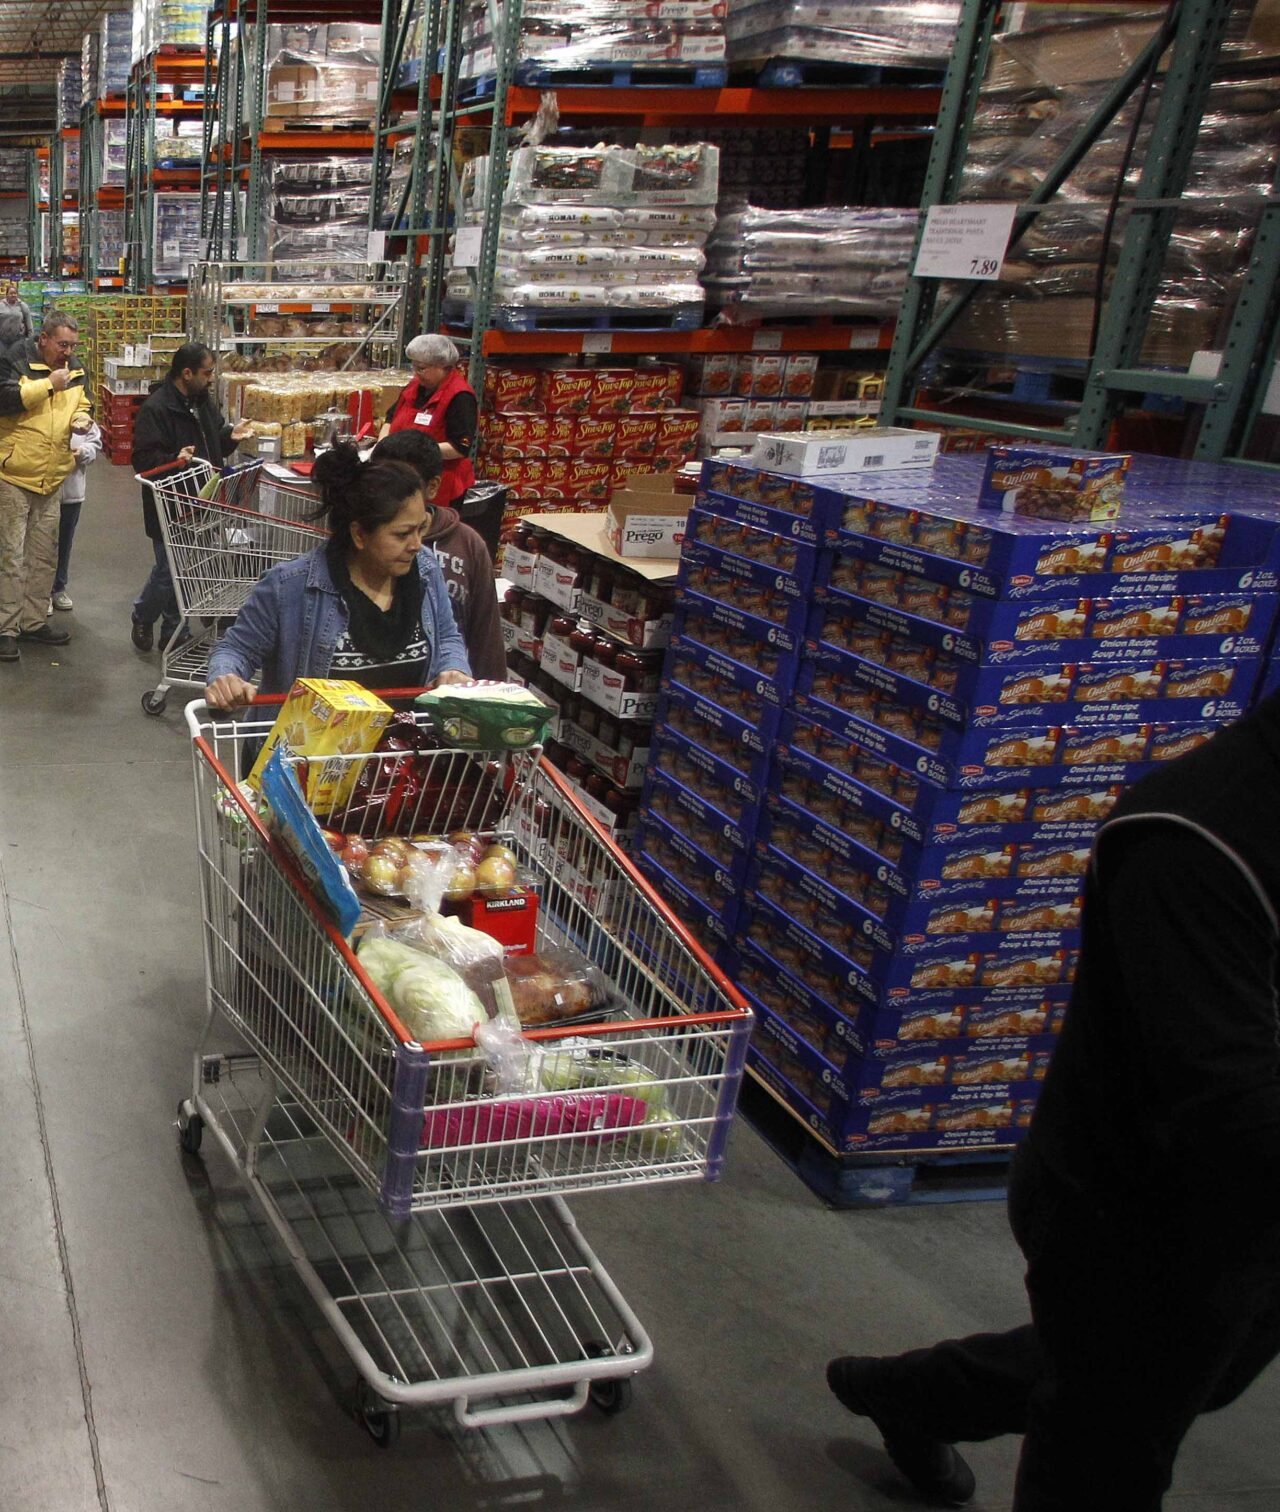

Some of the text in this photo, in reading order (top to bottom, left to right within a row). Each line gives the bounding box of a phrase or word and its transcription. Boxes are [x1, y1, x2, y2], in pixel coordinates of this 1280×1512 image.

[970, 260, 998, 276] 7.89
[552, 379, 592, 397] Stove Top
[593, 378, 636, 397] Stove Top
[652, 376, 666, 388] Top
[576, 422, 616, 440] Stove Top
[617, 422, 656, 440] Stove Top
[658, 420, 699, 440] Stove Top
[570, 464, 609, 481] Stove Top
[1003, 471, 1038, 485] Onion
[676, 520, 684, 528] 18
[792, 520, 800, 535] 6
[626, 530, 663, 544] Prego
[1123, 549, 1158, 568] Onion
[775, 576, 783, 590] 6
[959, 570, 970, 588] 6
[972, 572, 990, 585] 2oz.
[1120, 574, 1178, 584] Onion Recipe
[1238, 572, 1253, 589] 6
[1252, 578, 1278, 588] BOXES
[1256, 571, 1274, 580] 2oz.
[972, 582, 996, 596] BOXES
[1111, 583, 1178, 594] Soup & Dip Mix
[579, 596, 603, 618] Prego
[1103, 615, 1139, 635] Onion
[1195, 612, 1230, 632] Onion
[768, 628, 776, 642] 6
[942, 634, 952, 650] 6
[1237, 636, 1256, 646] 2oz.
[1100, 639, 1158, 650] Onion Recipe
[1220, 636, 1234, 654] 6
[1234, 644, 1260, 654] BOXES
[1092, 650, 1115, 658] Soup
[1124, 648, 1139, 658] Dip
[1140, 649, 1158, 657] Mix
[1087, 680, 1121, 698] Onion
[1177, 676, 1212, 696] Onion
[310, 701, 320, 714] 2
[624, 698, 655, 714] Pre
[928, 694, 938, 711] 6
[1082, 702, 1139, 714] Onion Recipe
[1202, 700, 1216, 718] 6
[939, 708, 961, 722] BOXES
[1216, 708, 1242, 717] BOXES
[1073, 742, 1108, 760] Onion
[917, 756, 927, 772] 6
[486, 898, 526, 908] KIRKLAND
